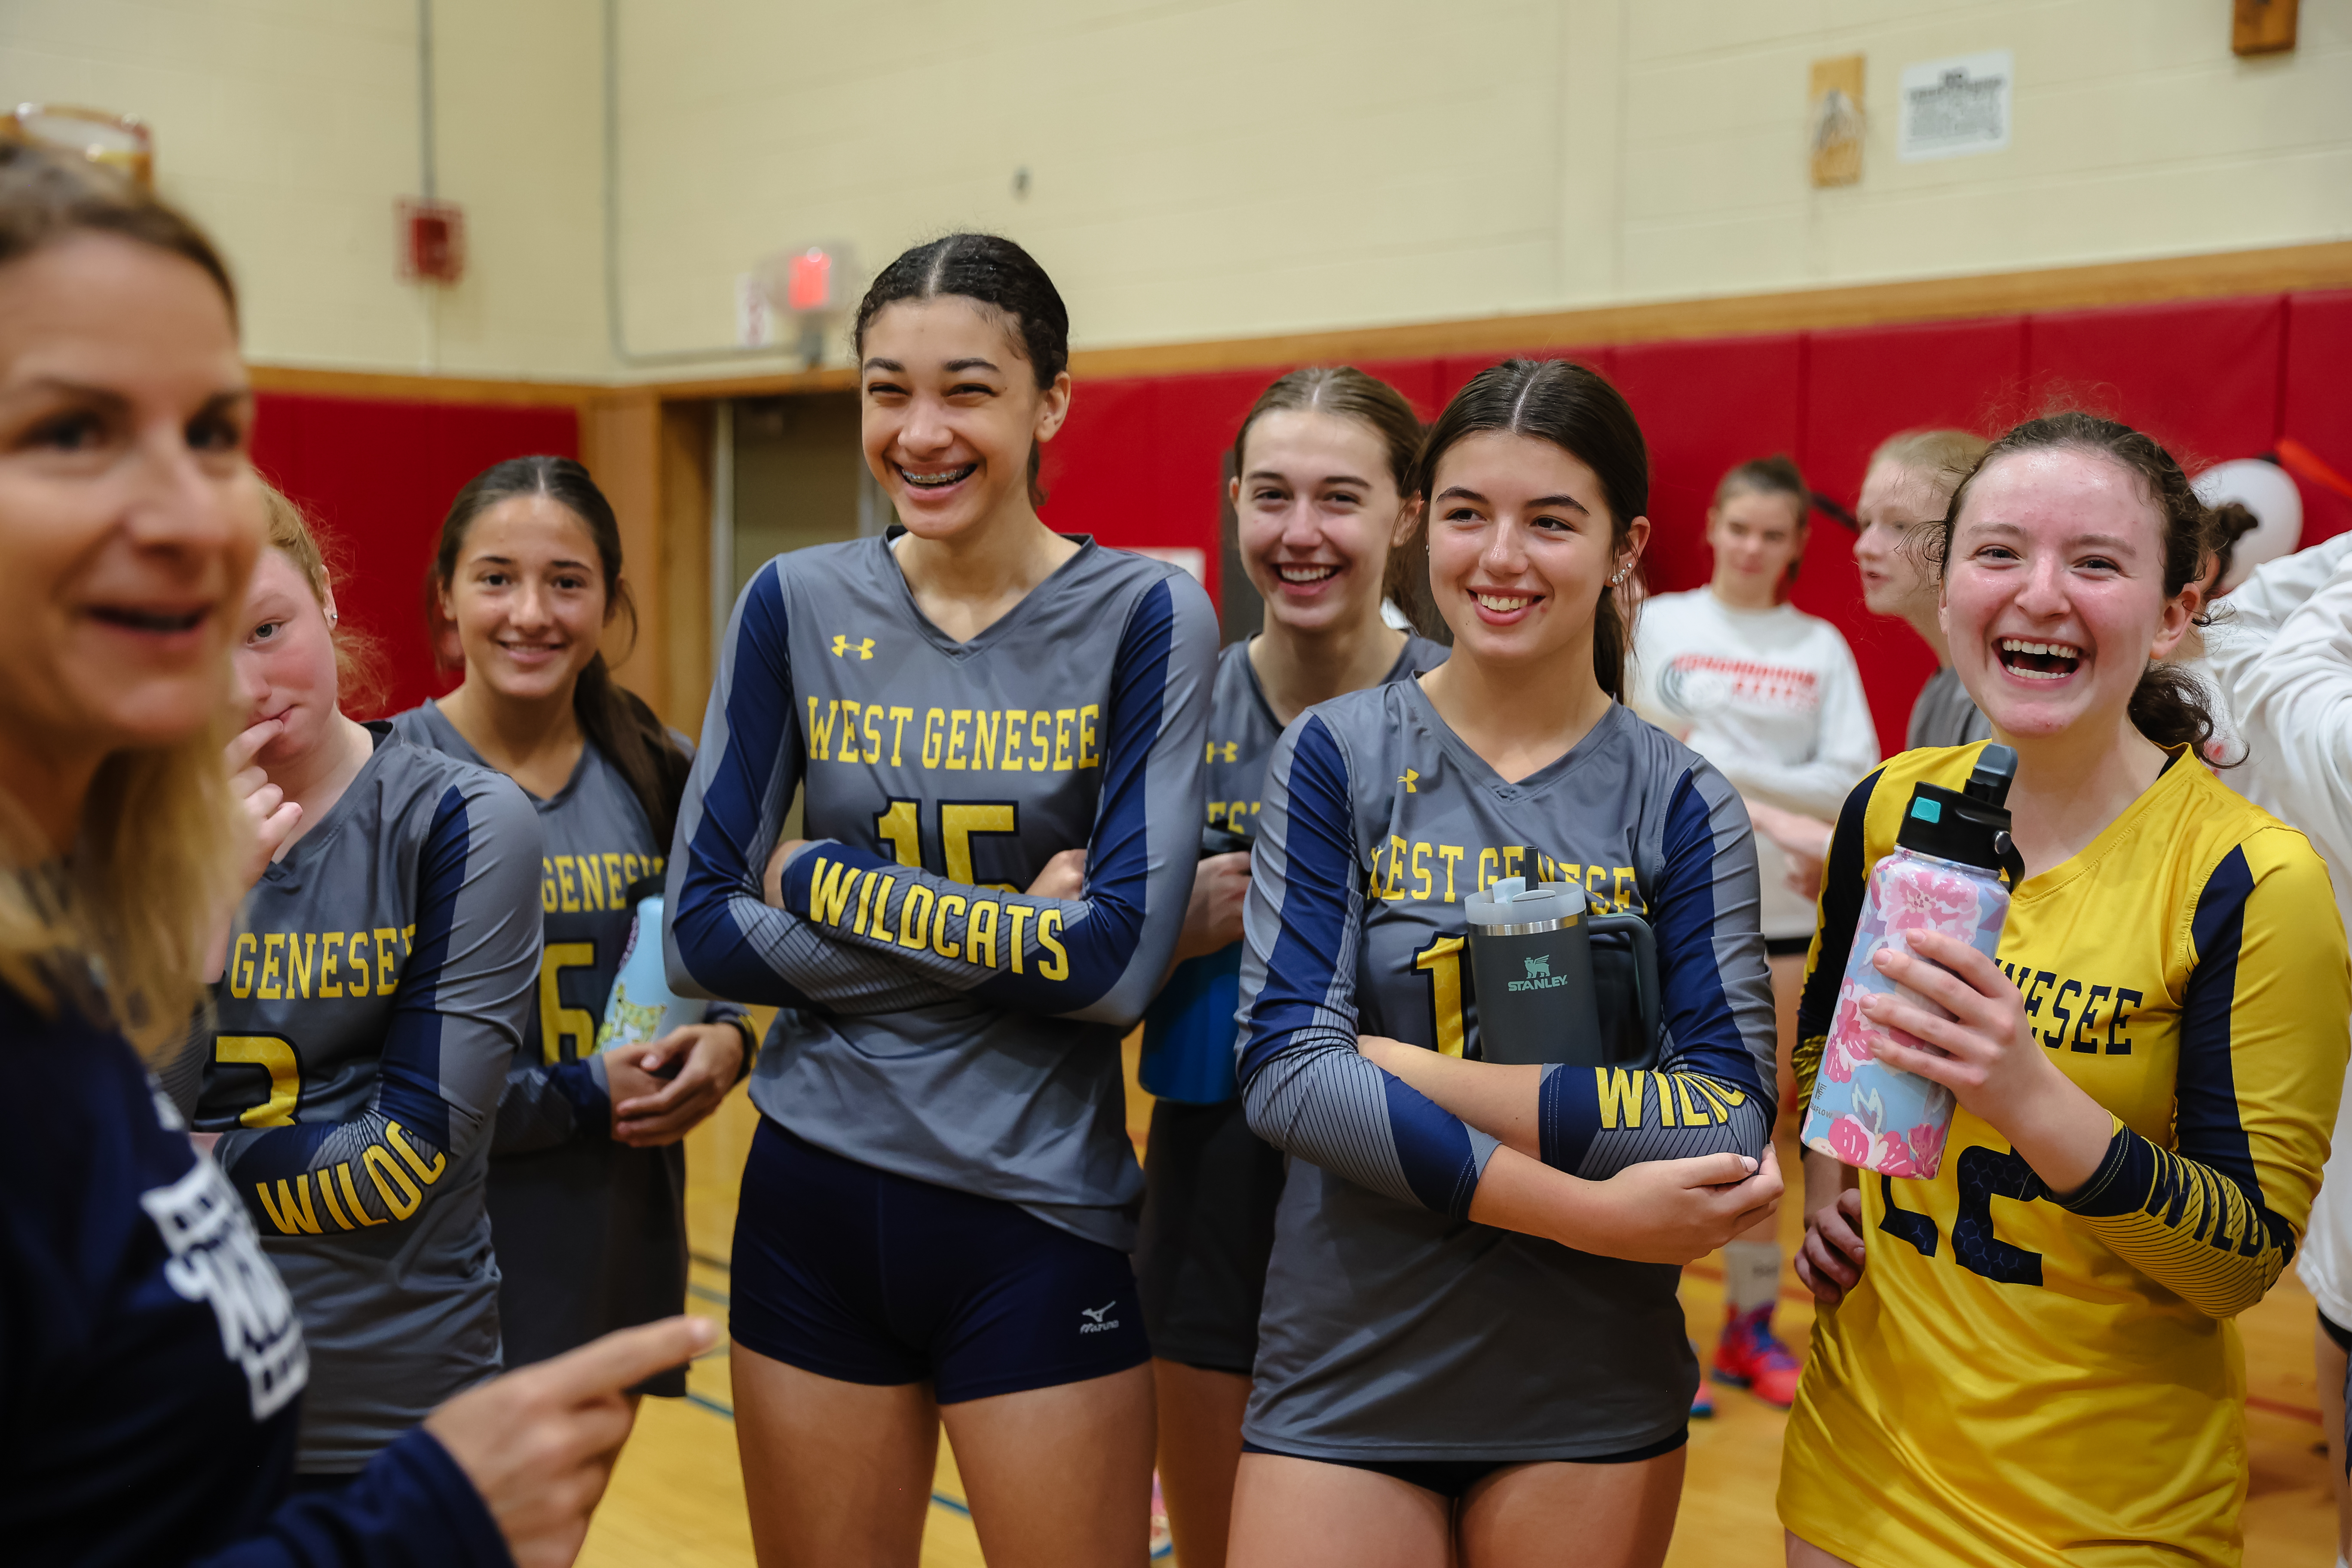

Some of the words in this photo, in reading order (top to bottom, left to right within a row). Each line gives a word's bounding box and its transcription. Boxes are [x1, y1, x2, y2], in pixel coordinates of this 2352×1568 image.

[807, 696, 914, 768] WEST
[922, 704, 1100, 772] GENESEE
[542, 852, 665, 914] GENES
[1477, 845, 1649, 916] GESE
[809, 857, 1069, 981] WILDCATS
[1508, 974, 1568, 992] STANLEY
[1994, 958, 2144, 1055] ESEE
